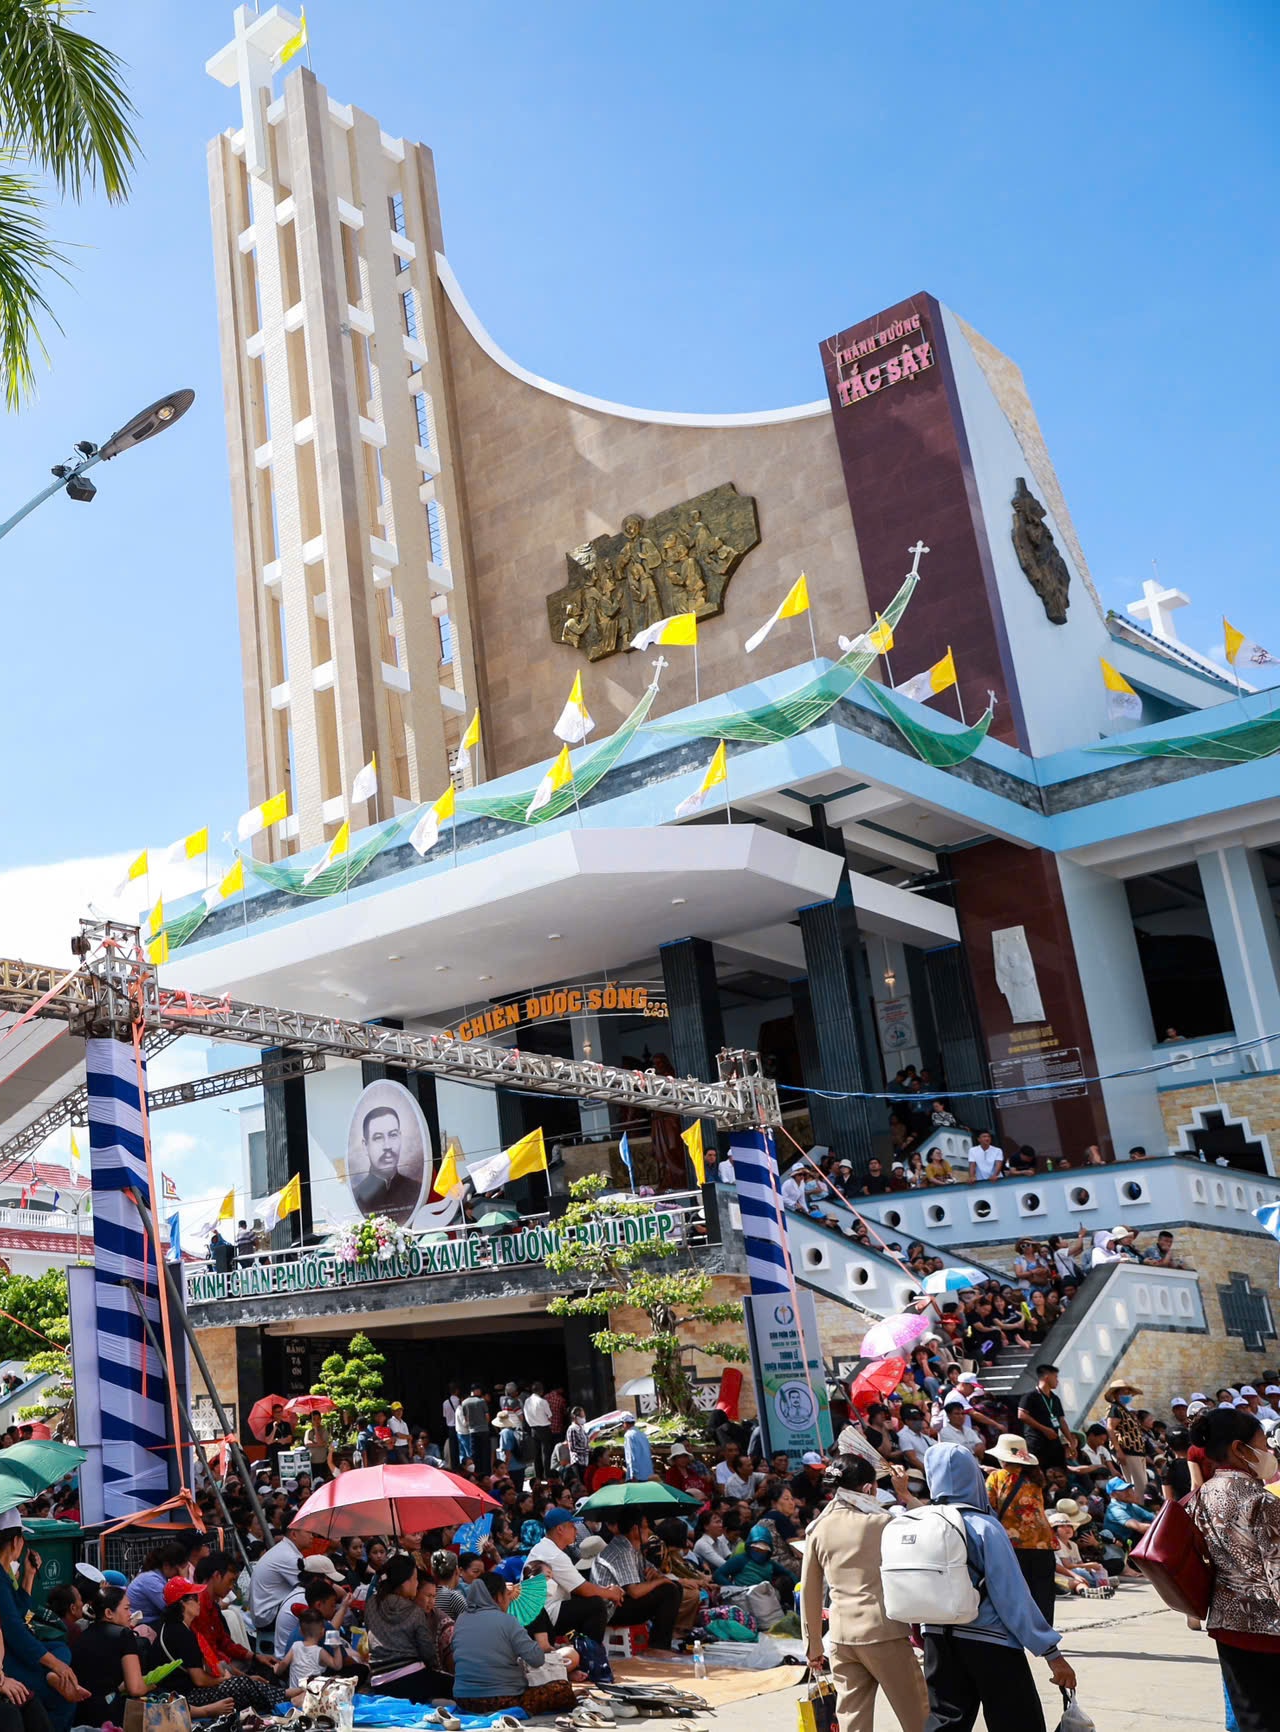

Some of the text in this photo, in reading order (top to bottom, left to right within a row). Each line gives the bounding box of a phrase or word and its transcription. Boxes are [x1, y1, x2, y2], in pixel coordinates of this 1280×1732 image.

[836, 314, 920, 365] THÁNH ĐƯỜNG
[886, 342, 931, 383] SẬY
[459, 1004, 521, 1042] CHIÊN
[526, 988, 583, 1019] ĐƯỢC
[230, 1263, 274, 1297] CHÂN
[427, 1232, 482, 1274] XAVIÊ
